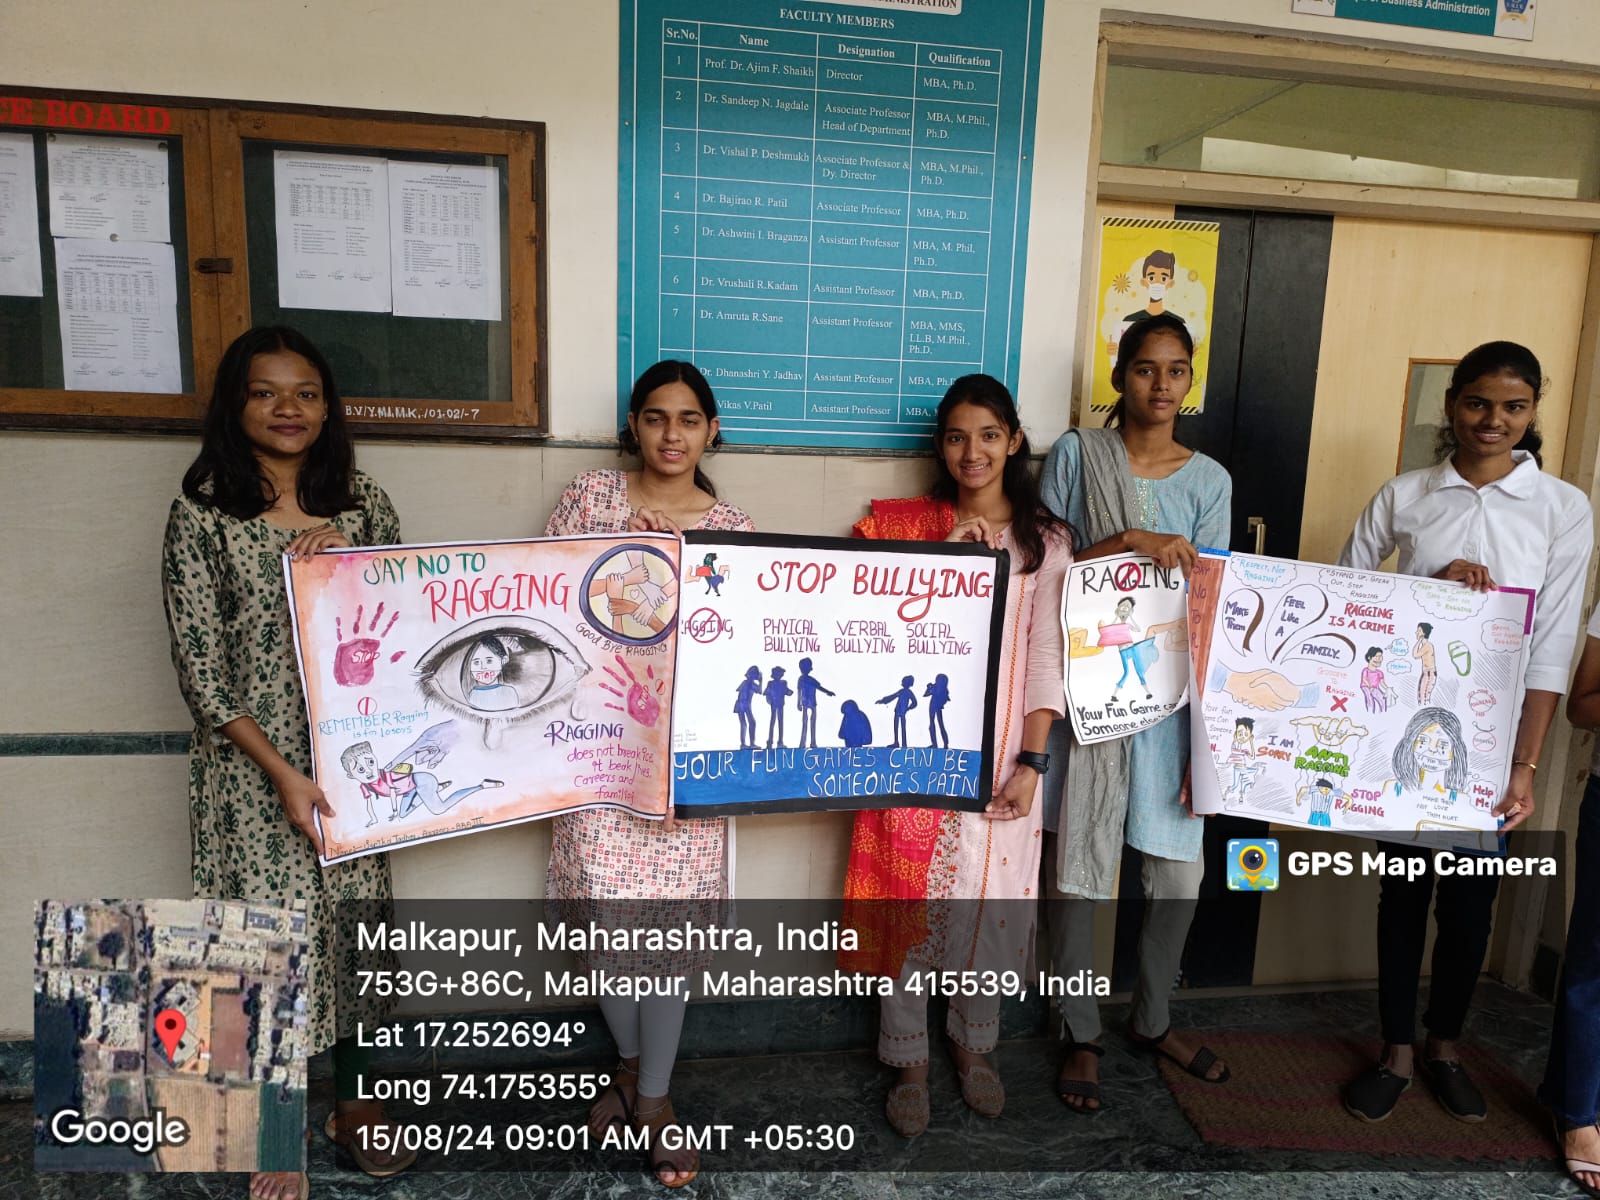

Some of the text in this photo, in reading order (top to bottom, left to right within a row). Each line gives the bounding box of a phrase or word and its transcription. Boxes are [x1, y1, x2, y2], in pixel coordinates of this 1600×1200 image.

[1425, 0, 1490, 16] Administration
[780, 8, 895, 29] FACULTY MEMBERS
[666, 27, 698, 40] Sr.No.
[739, 34, 769, 47] Name
[838, 43, 895, 58] Designation
[929, 51, 991, 67] Qualification
[705, 58, 814, 77] Prof. Dr. Ajim F. Shaikh
[826, 69, 864, 82] Director
[923, 78, 977, 91] MBA, Ph.D.
[675, 90, 681, 100] 2
[704, 92, 809, 111] Dr. Sandeep N. Jagdale
[46, 99, 170, 134] BOARD
[824, 103, 910, 120] Associate Professor
[927, 111, 953, 124] MBA,
[822, 119, 911, 138] Head of Department
[925, 127, 950, 139] Ph.D.
[675, 142, 680, 151] 3
[703, 144, 809, 162] Dr. Vishal P. Deshmukh
[815, 154, 900, 169] Associate Professor
[920, 161, 947, 173] MBA,
[822, 168, 876, 180] Dy. Director
[921, 175, 945, 186] Ph.D.
[674, 191, 680, 200] 4
[703, 193, 788, 208] Dr. Bajirao Patil
[816, 201, 901, 215] Associate Professor
[916, 207, 969, 220] MBA, Ph.D.
[674, 225, 680, 234] 5
[702, 226, 808, 243] Dr. Ashwini Braganza
[818, 234, 900, 248] Assistant Professor
[913, 240, 939, 252] MBA,
[913, 256, 937, 267] Ph.D.
[673, 275, 679, 284] 6
[701, 276, 798, 291] Dr. Vrushali R.Kadam
[813, 284, 896, 297] Assistant Professor
[912, 289, 965, 300] MBA, Ph.D.
[673, 308, 679, 317] 7
[700, 309, 783, 323] Dr. Amruta R.Sane
[812, 316, 893, 329] Assistant Professor
[910, 320, 965, 333] MBA, MMS,
[909, 345, 933, 355] Ph.D.
[700, 367, 803, 381] Dr. Dhanashri Jadhav
[813, 373, 894, 385] Assistant Professor
[908, 376, 935, 387] MBA,
[717, 400, 772, 411] Vikas V.Patil
[811, 404, 891, 416] Assistant Professor
[363, 552, 487, 585] SAY NO TO
[422, 572, 573, 624] RAGGING
[757, 561, 993, 622] STOP BULLYING
[1283, 595, 1306, 610] FEEL
[1344, 602, 1395, 620] RAGGING
[763, 618, 956, 639] PHYICAL VERBAL SOCIAL
[1275, 626, 1284, 637] A
[1328, 615, 1396, 635] IS A CRIME
[626, 643, 667, 656] RAGGING
[764, 636, 973, 655] BULLYING BULLYING BULLYING
[351, 647, 380, 664] STOP
[475, 671, 496, 681] STOP
[1105, 702, 1128, 718] Fun
[1129, 700, 1161, 715] Game
[318, 712, 391, 736] REMEMBER
[1081, 720, 1138, 736] Someone
[544, 720, 624, 746] RAGGING
[1267, 735, 1294, 748] I AM
[567, 747, 594, 762] does
[596, 743, 614, 757] not
[1256, 746, 1292, 762] SORRY
[674, 747, 971, 780] YOUR FUN GAMES CAN BE
[1294, 756, 1350, 777] RAGGING
[574, 773, 615, 787] Careers
[926, 771, 978, 798] PAIN
[1351, 788, 1381, 801] STOP
[1472, 784, 1494, 798] Help
